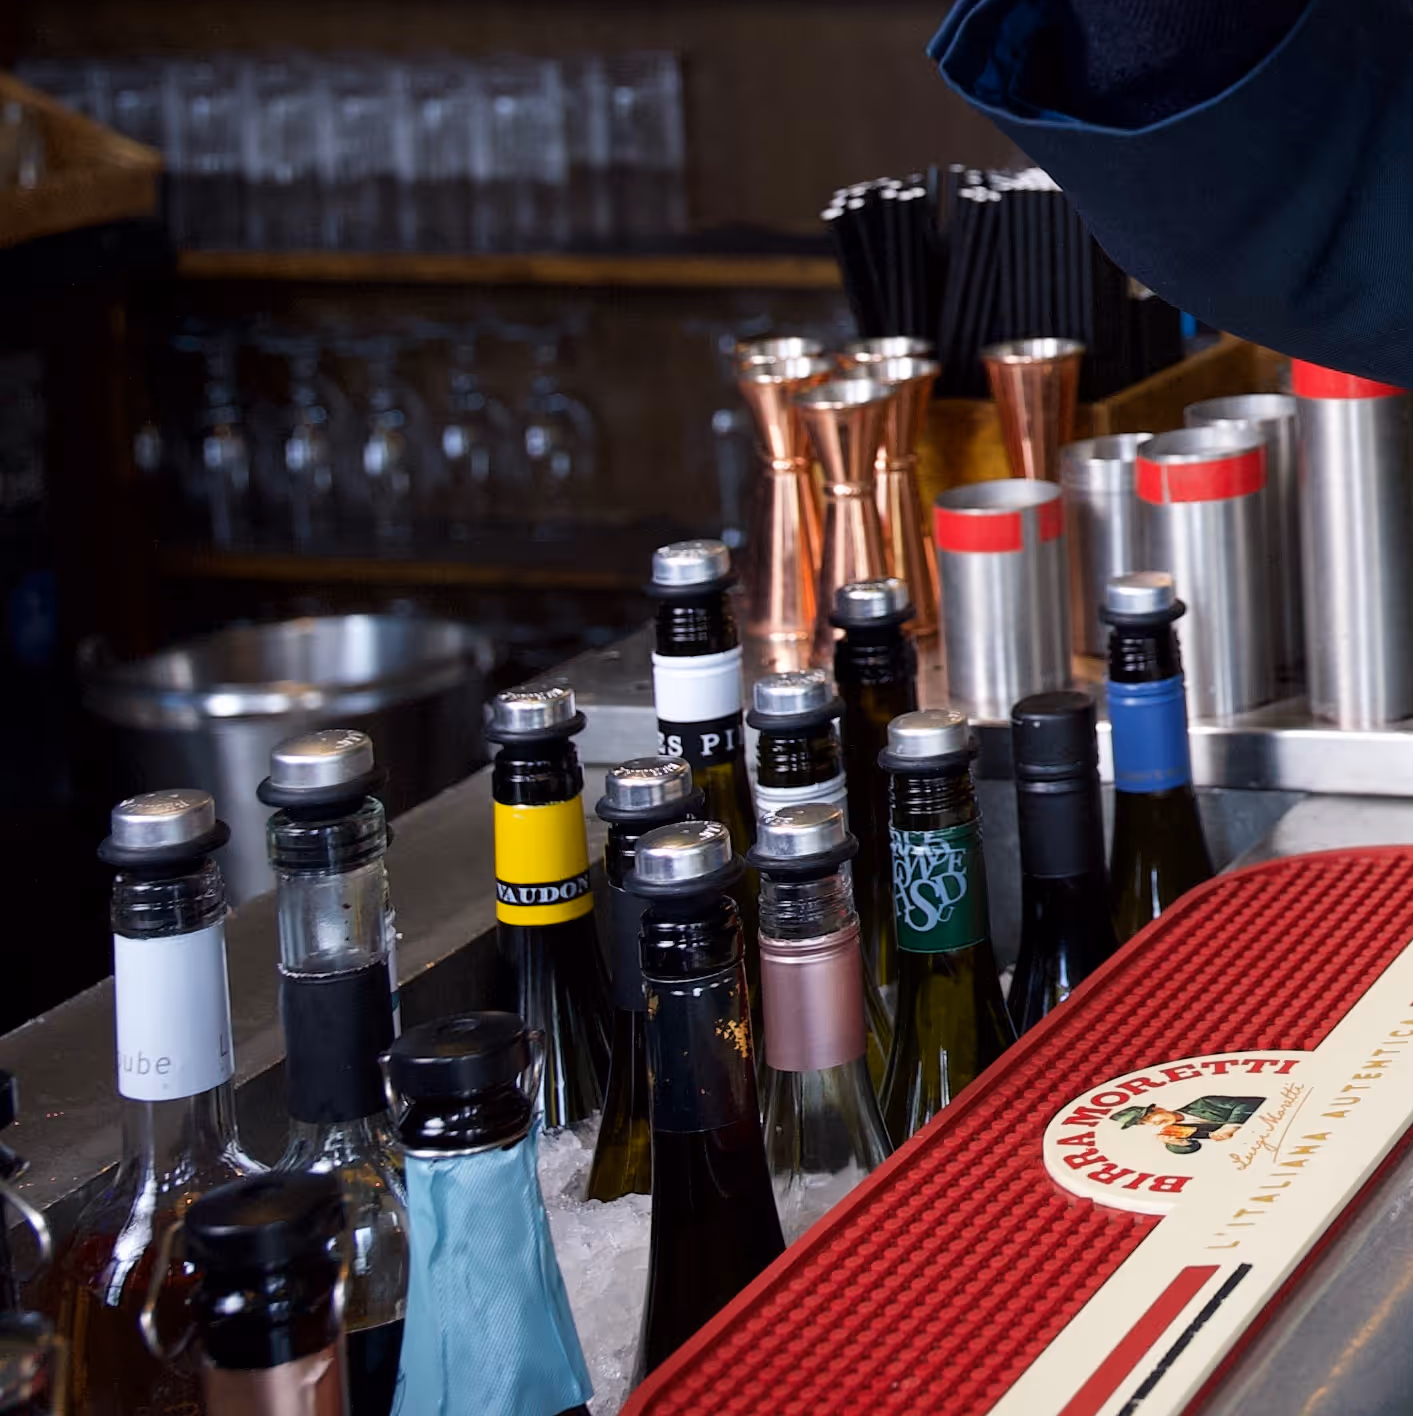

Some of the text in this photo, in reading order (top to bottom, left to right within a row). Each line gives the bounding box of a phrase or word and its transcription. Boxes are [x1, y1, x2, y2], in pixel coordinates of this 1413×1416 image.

[1061, 1058, 1300, 1129] MORETTI
[1056, 1130, 1194, 1194] BIRRA
[1203, 1131, 1334, 1250] L'ITALIANA
